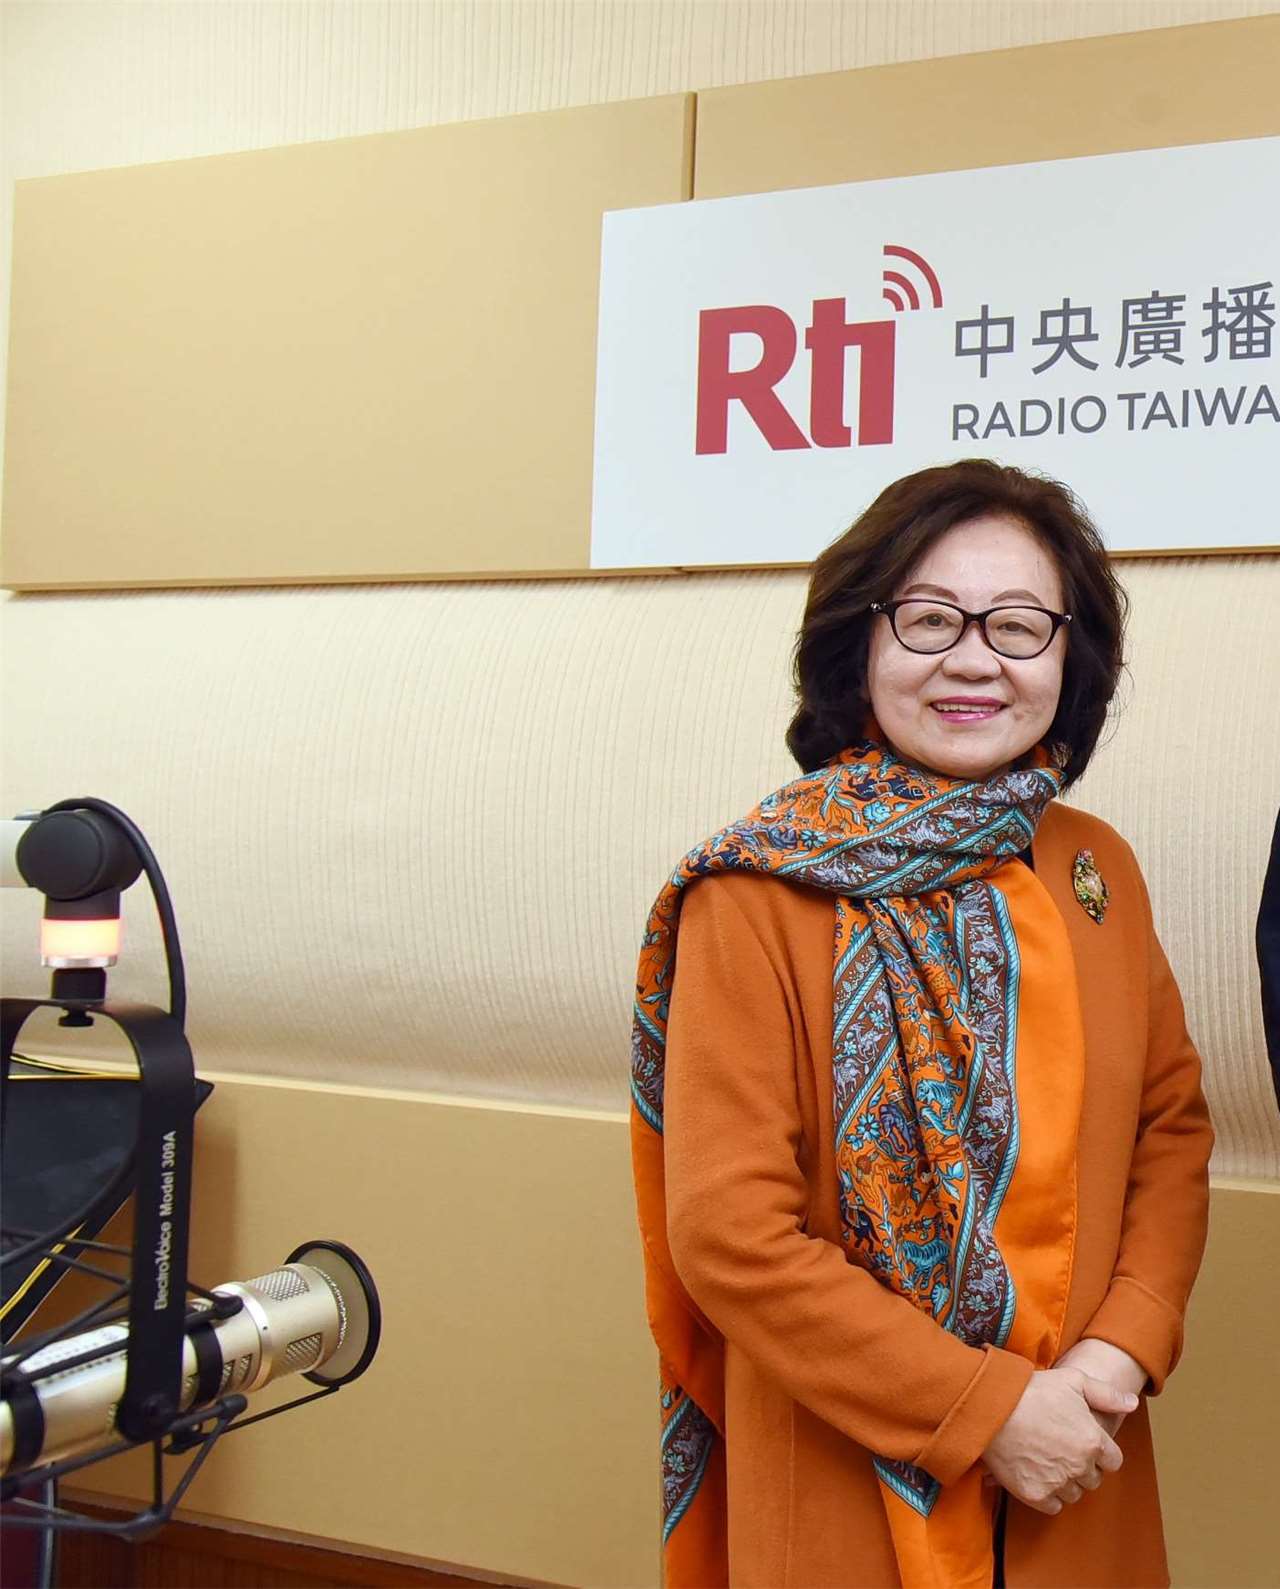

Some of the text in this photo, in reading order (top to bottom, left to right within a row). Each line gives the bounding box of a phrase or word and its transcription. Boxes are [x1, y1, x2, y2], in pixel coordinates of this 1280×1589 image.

[952, 395, 1107, 440] RADIO
[162, 1130, 177, 1168] 309A
[159, 1171, 176, 1217] Model
